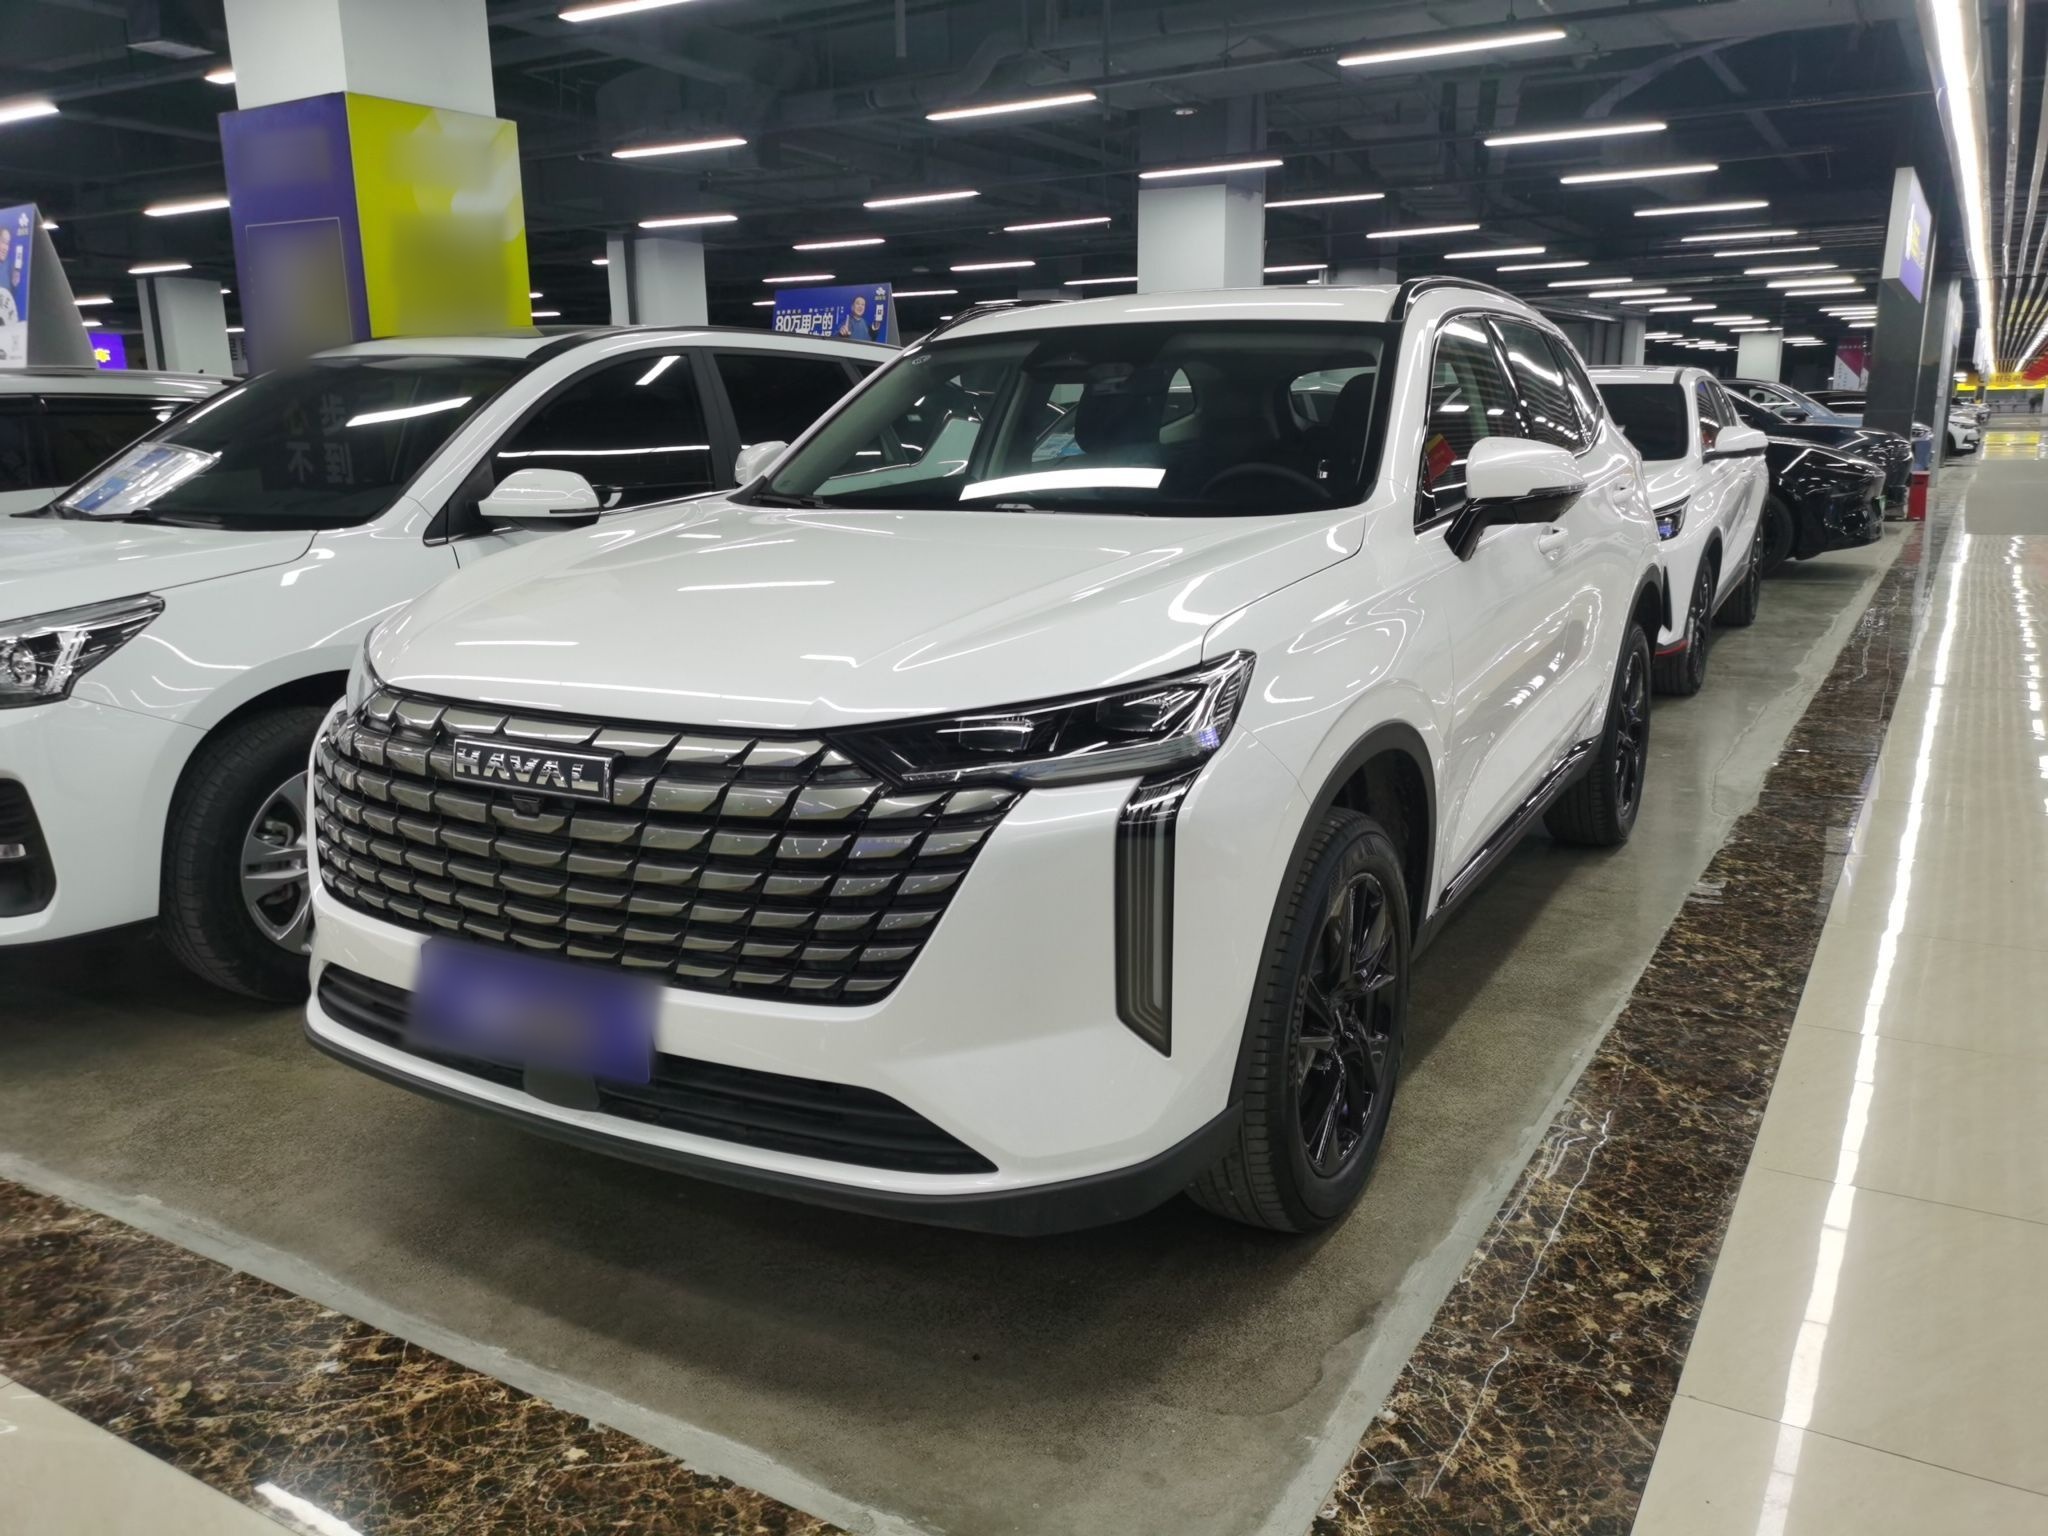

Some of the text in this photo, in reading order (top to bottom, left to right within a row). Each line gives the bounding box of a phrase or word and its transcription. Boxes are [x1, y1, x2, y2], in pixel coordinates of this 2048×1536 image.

[775, 313, 833, 332] 80万用户的
[456, 747, 599, 792] HAVAL
[1288, 974, 1306, 1087] KUMHO
